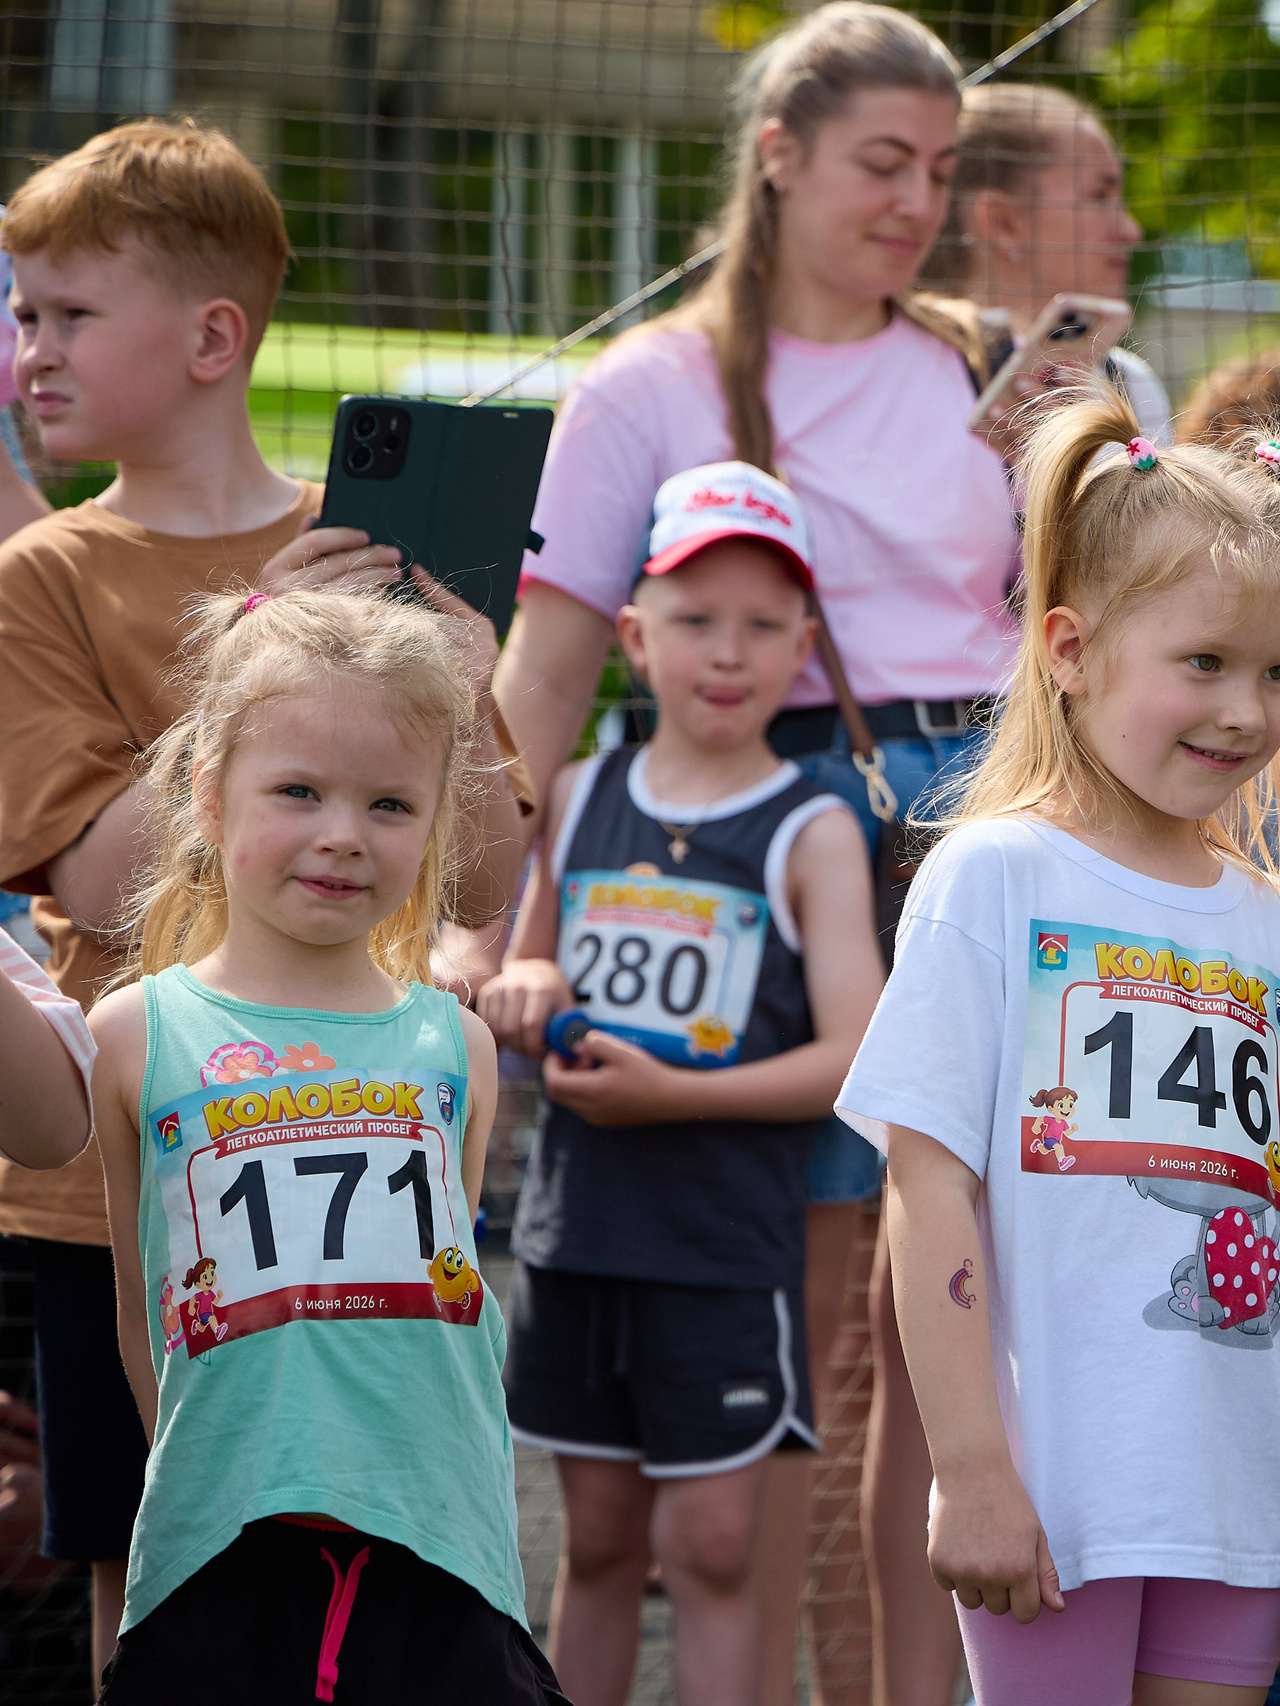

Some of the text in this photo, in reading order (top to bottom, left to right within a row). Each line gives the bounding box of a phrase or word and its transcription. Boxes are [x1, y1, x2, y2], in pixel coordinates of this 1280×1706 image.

[574, 934, 707, 1016] 280
[1094, 942, 1268, 1017] КОЛОБОК
[1111, 985, 1260, 1028] ЛЕГКОАТЛЕТИЧЕСКИЙ ПРОБЕГ
[202, 1078, 424, 1140] КОЛОБОК
[1084, 1011, 1271, 1146] 146
[226, 1120, 412, 1152] ЛЕГКОАТЛЕТИЧЕСКИЙ ПРОБЕГ
[1148, 1155, 1239, 1180] 6 июня 2026 г.
[219, 1150, 435, 1271] 171
[295, 1296, 388, 1311] 6 июня 2026 г.
